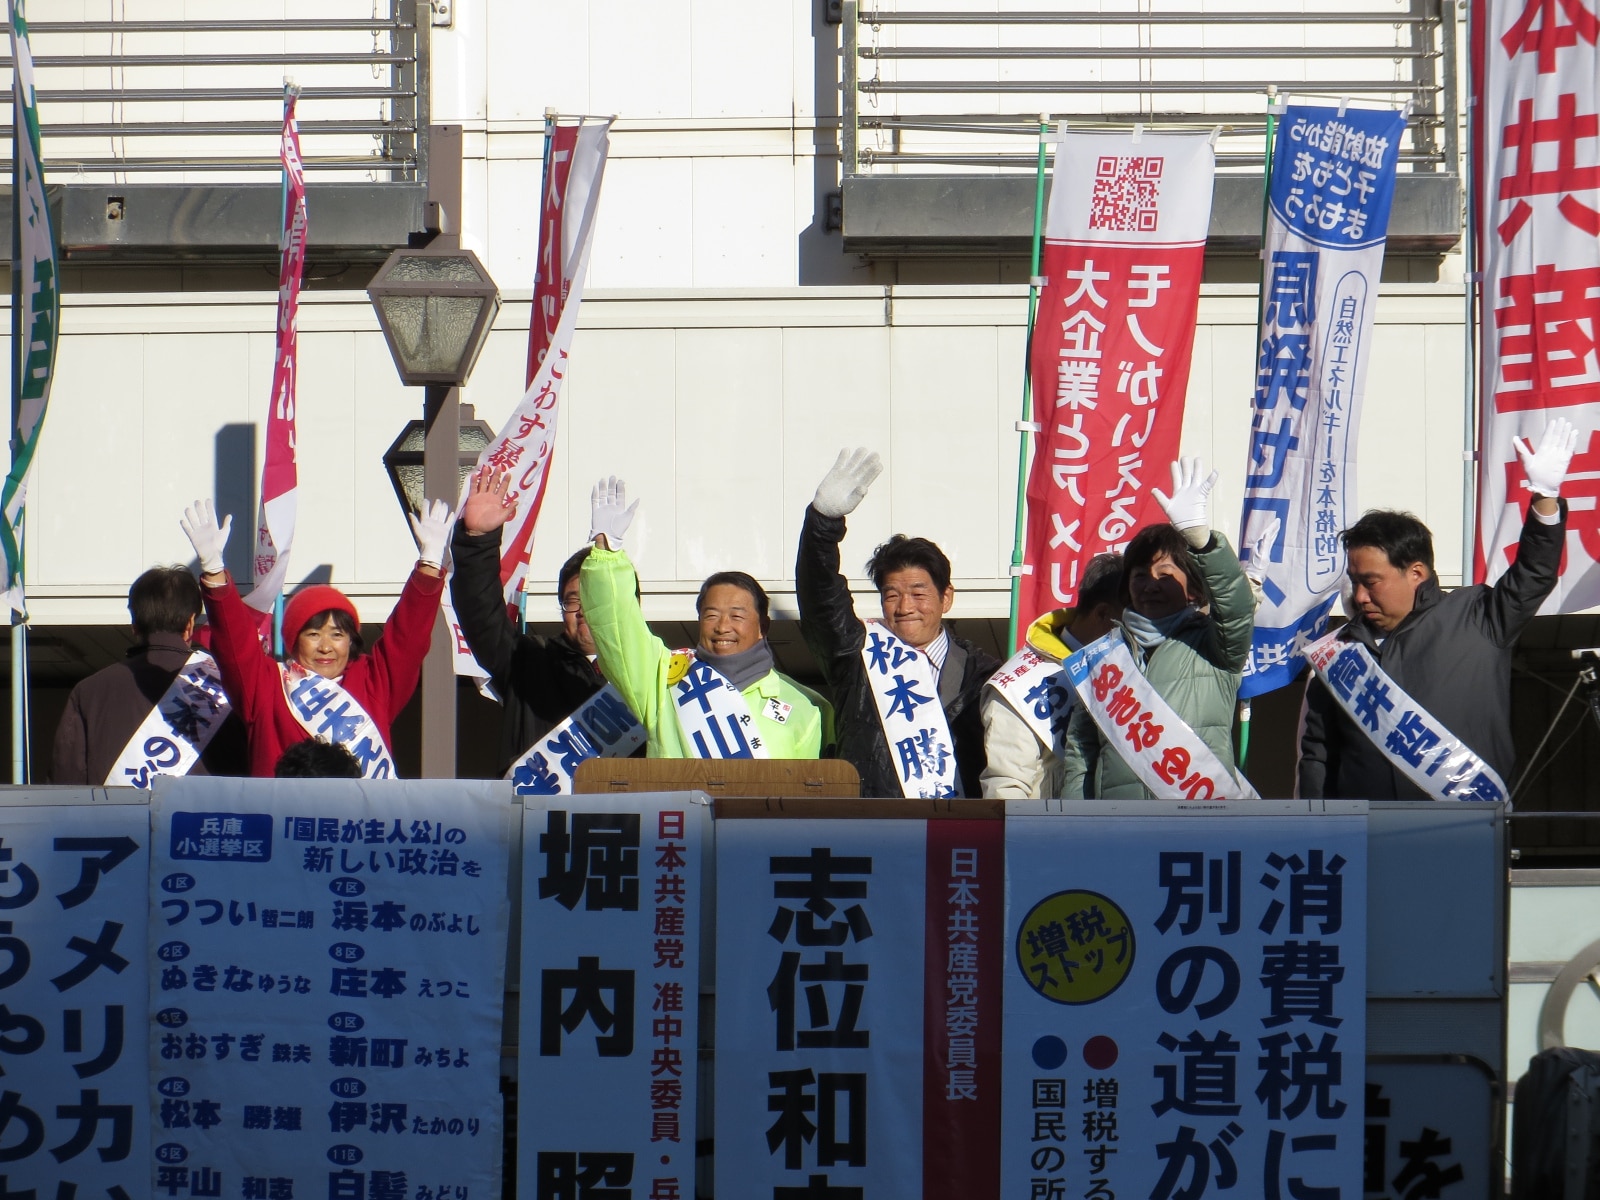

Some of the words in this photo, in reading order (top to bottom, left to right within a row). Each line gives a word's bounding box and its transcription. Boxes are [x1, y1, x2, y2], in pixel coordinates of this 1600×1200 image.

[200, 817, 243, 836] 兵庫
[284, 816, 467, 845] 「国民が主人公」の
[176, 837, 264, 857] 小選挙区
[303, 846, 482, 877] 新しい政治を
[167, 877, 188, 889] 1区
[336, 882, 358, 893] 7区
[653, 811, 686, 969] 日本共産党
[1026, 905, 1111, 958] 増税
[163, 945, 183, 957] 2区
[335, 946, 357, 959] 8区
[1030, 927, 1128, 992] ストップ
[946, 848, 979, 1101] 日本共産党委員長
[162, 1012, 181, 1024] 3区
[335, 1016, 357, 1028] 9区
[765, 848, 873, 1200] 志位和
[1149, 850, 1243, 1200] 別の道が
[1256, 849, 1347, 1200] 消費税に
[163, 1081, 184, 1093] 4区
[337, 1082, 358, 1094] 10区
[161, 1148, 181, 1160] 5区
[333, 1150, 355, 1161] 11区
